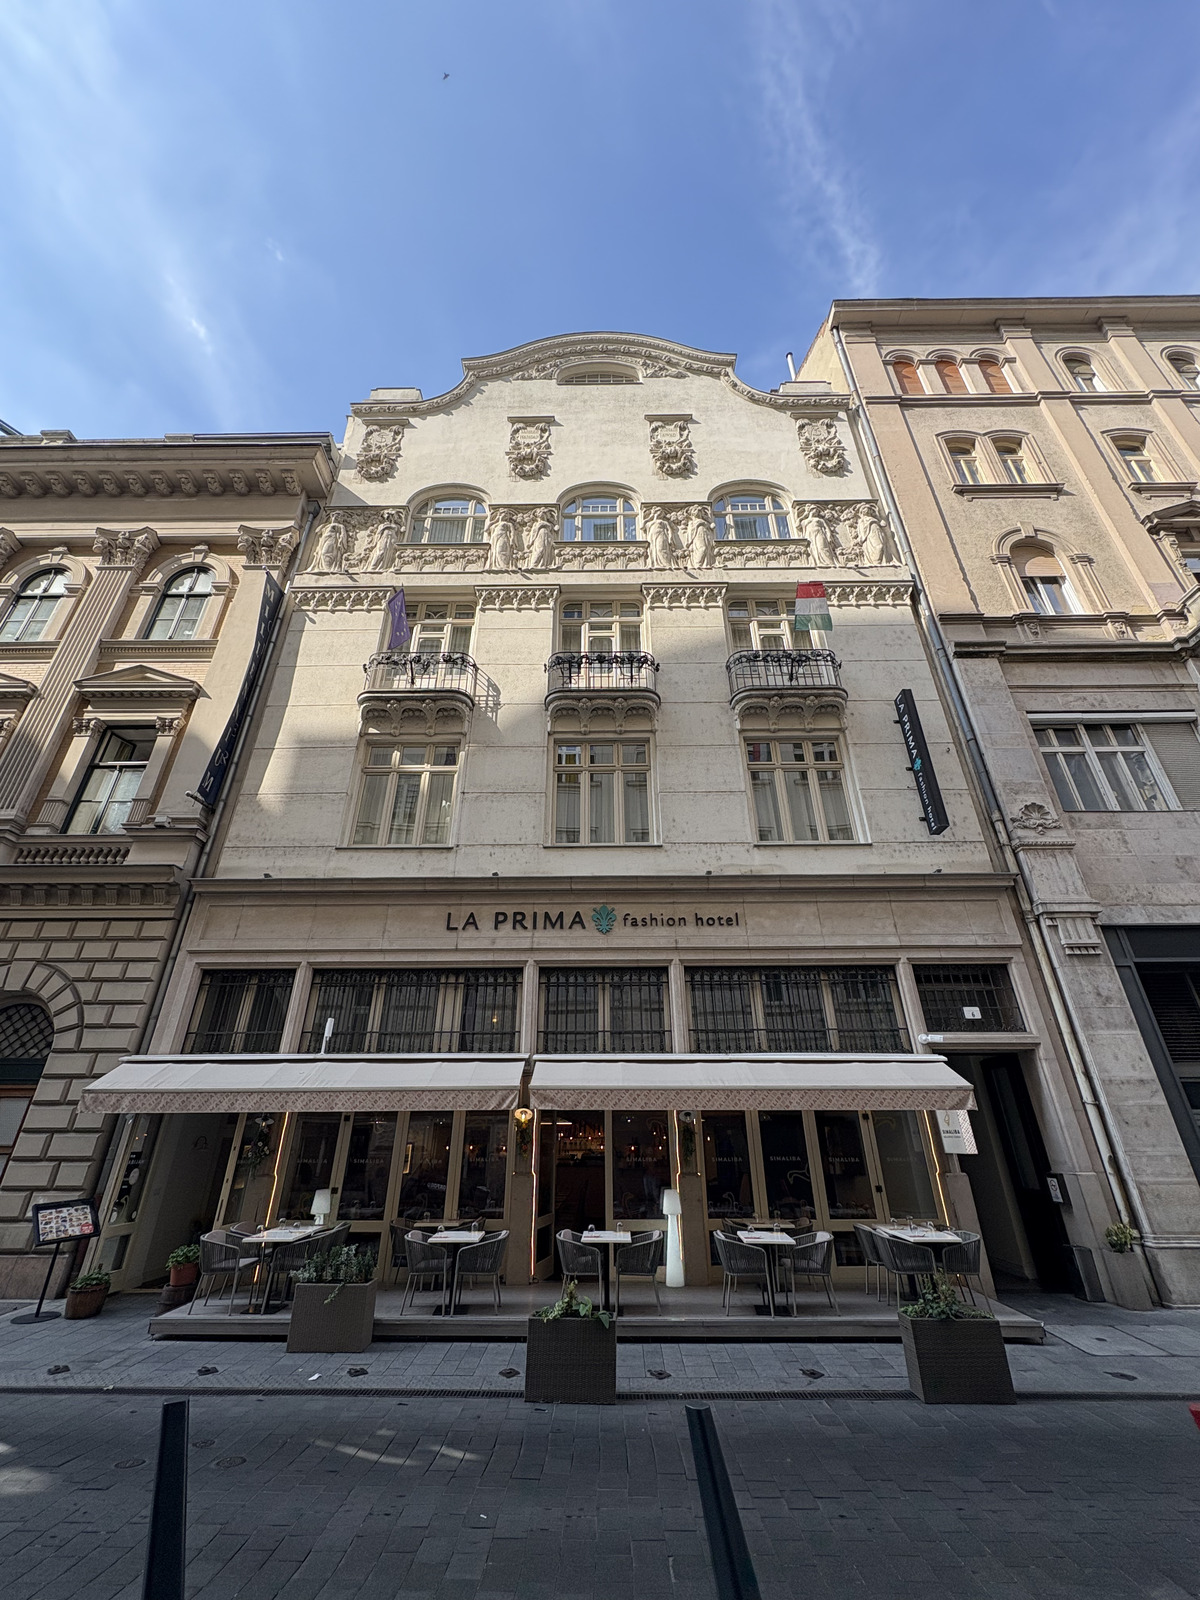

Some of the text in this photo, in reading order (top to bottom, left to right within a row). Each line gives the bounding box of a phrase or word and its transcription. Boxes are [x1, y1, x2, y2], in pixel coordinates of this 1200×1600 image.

[896, 694, 938, 831] LA PRIMA fashion hotel
[446, 911, 740, 931] LA PRIMA fashion hotel
